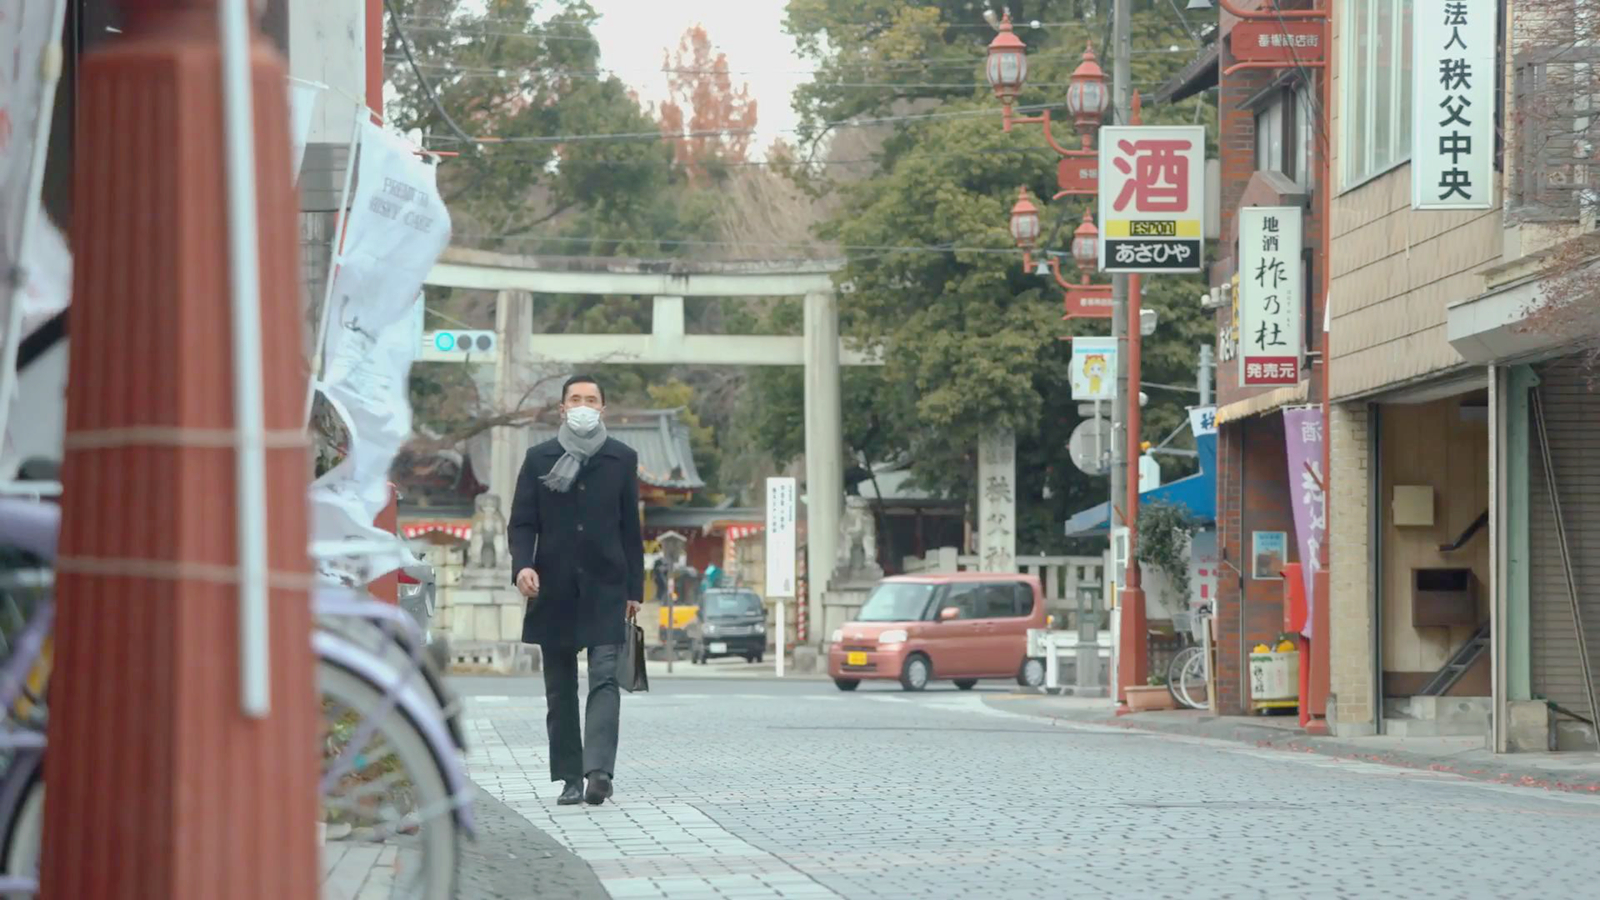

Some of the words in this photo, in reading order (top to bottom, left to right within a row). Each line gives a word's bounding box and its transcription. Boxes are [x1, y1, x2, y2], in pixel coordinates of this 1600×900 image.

[1438, 0, 1473, 200] 法人秩父中央
[1112, 139, 1192, 212] 酒
[1262, 215, 1279, 252] 地酒
[1115, 243, 1191, 263] あさひや
[1247, 362, 1295, 379] 発売元
